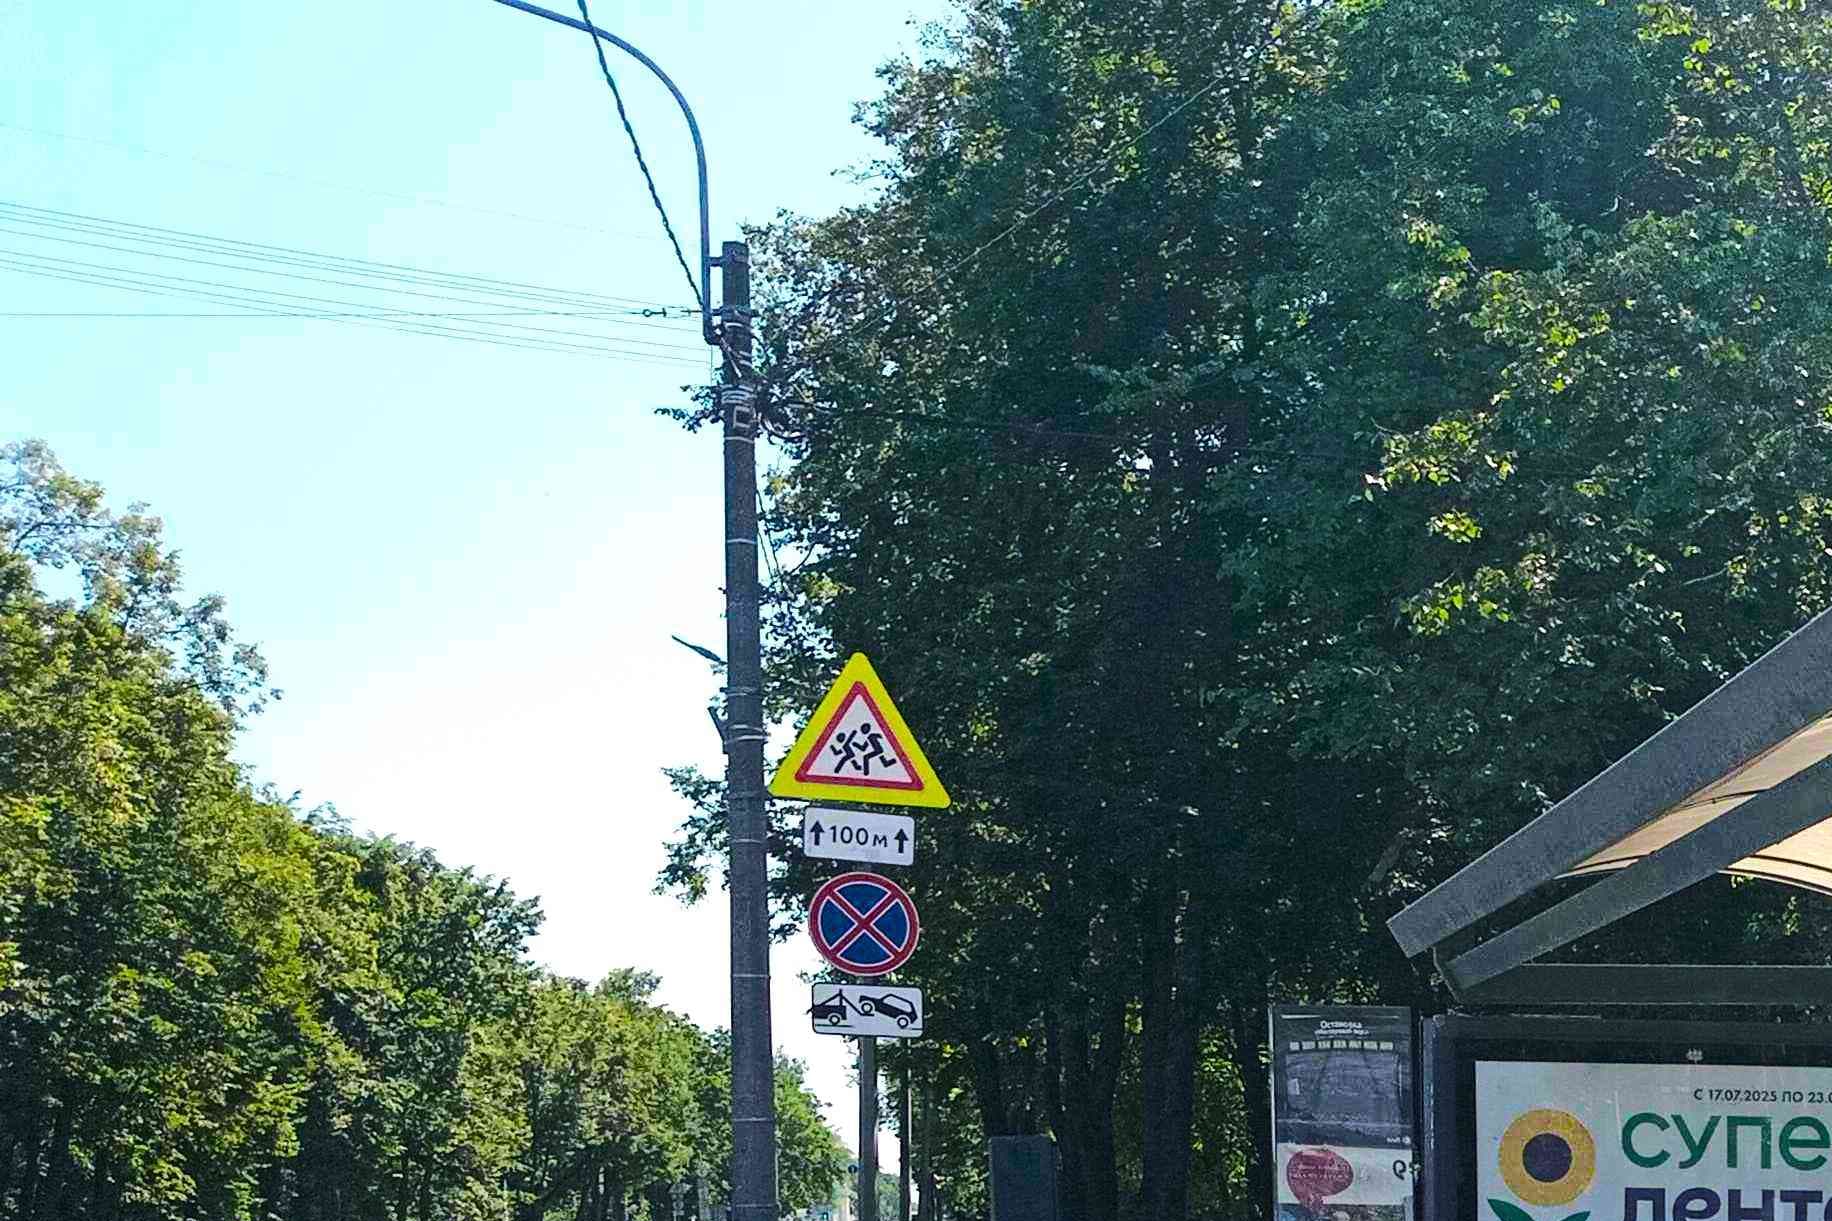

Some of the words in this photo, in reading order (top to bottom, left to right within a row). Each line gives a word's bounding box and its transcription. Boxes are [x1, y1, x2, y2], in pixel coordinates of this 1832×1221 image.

[829, 825, 869, 846] 100
[1693, 1088, 1703, 1101] С
[1708, 1088, 1777, 1102] 17.07.2025
[1781, 1090, 1804, 1103] ПО
